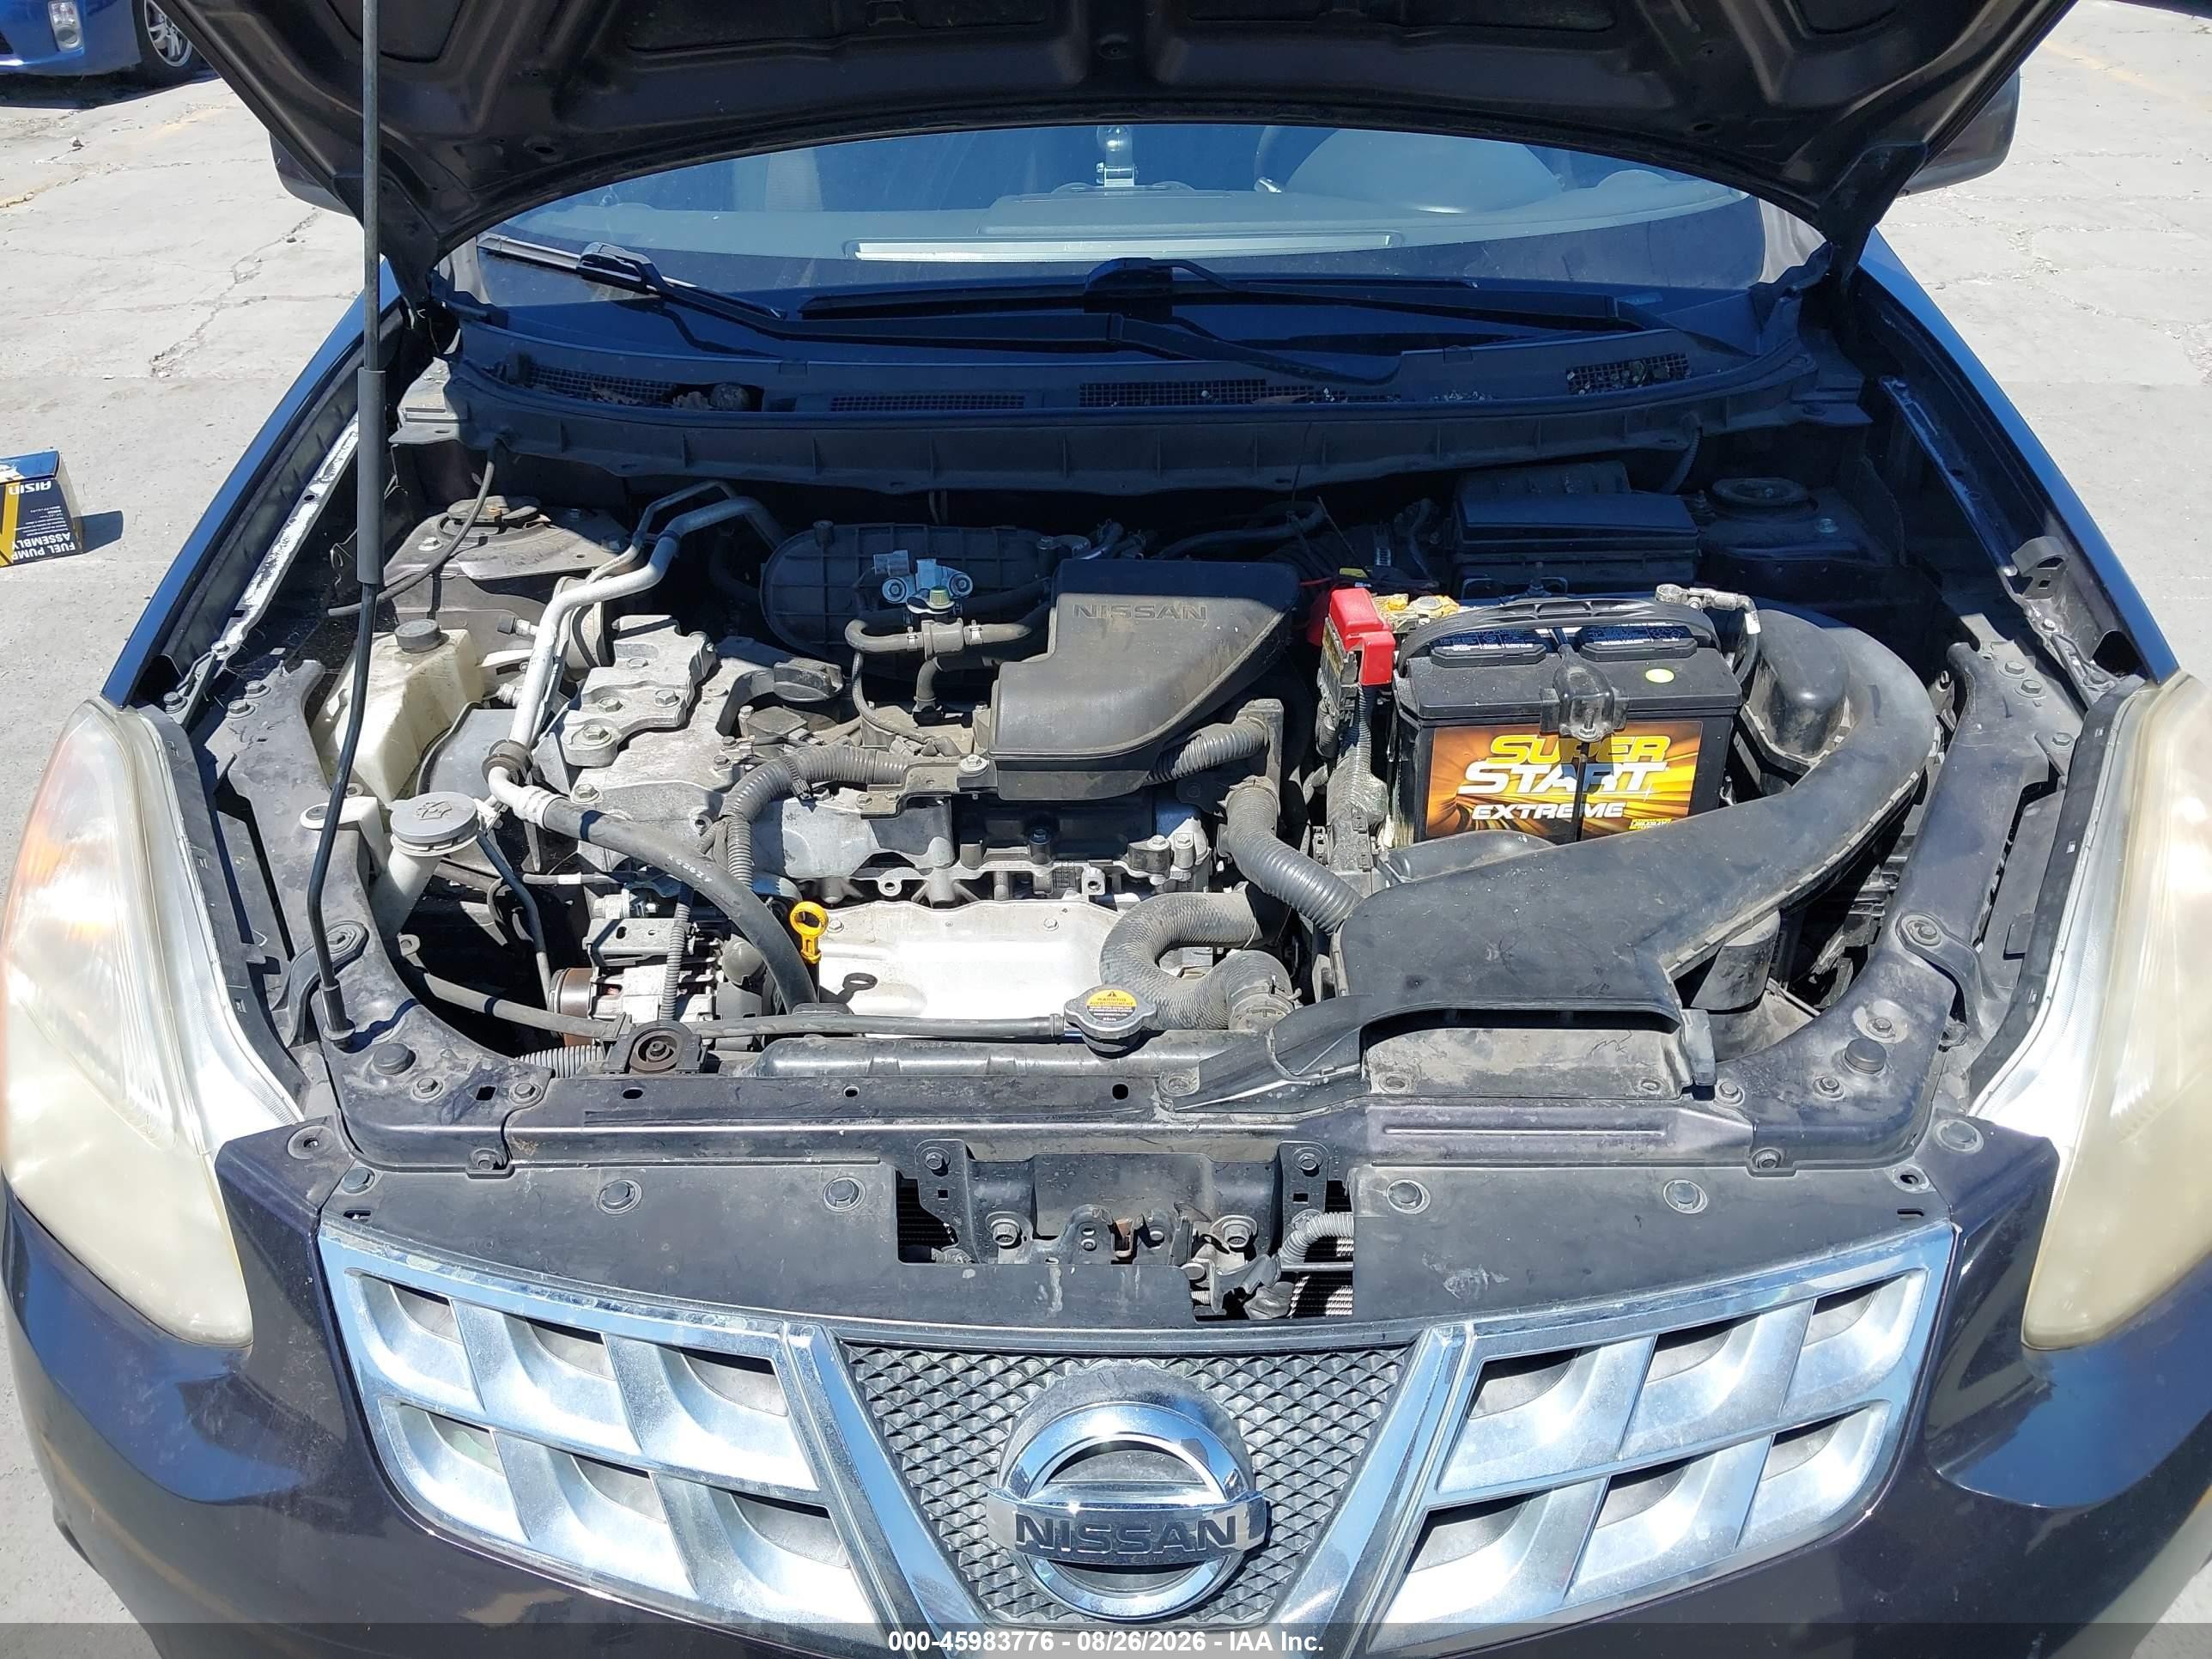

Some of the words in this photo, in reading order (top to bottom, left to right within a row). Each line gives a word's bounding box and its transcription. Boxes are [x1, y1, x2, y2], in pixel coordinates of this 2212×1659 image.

[8, 480, 52, 495] AISIN
[12, 532, 71, 550] ASSEMBLY
[47, 542, 76, 554] FUEL
[10, 546, 46, 561] PUMP
[1073, 604, 1207, 620] NISSAN
[1486, 735, 1671, 764] SUPER
[1457, 761, 1668, 795] START
[1473, 803, 1626, 820] EXTREME
[1015, 1513, 1238, 1555] NISSAN
